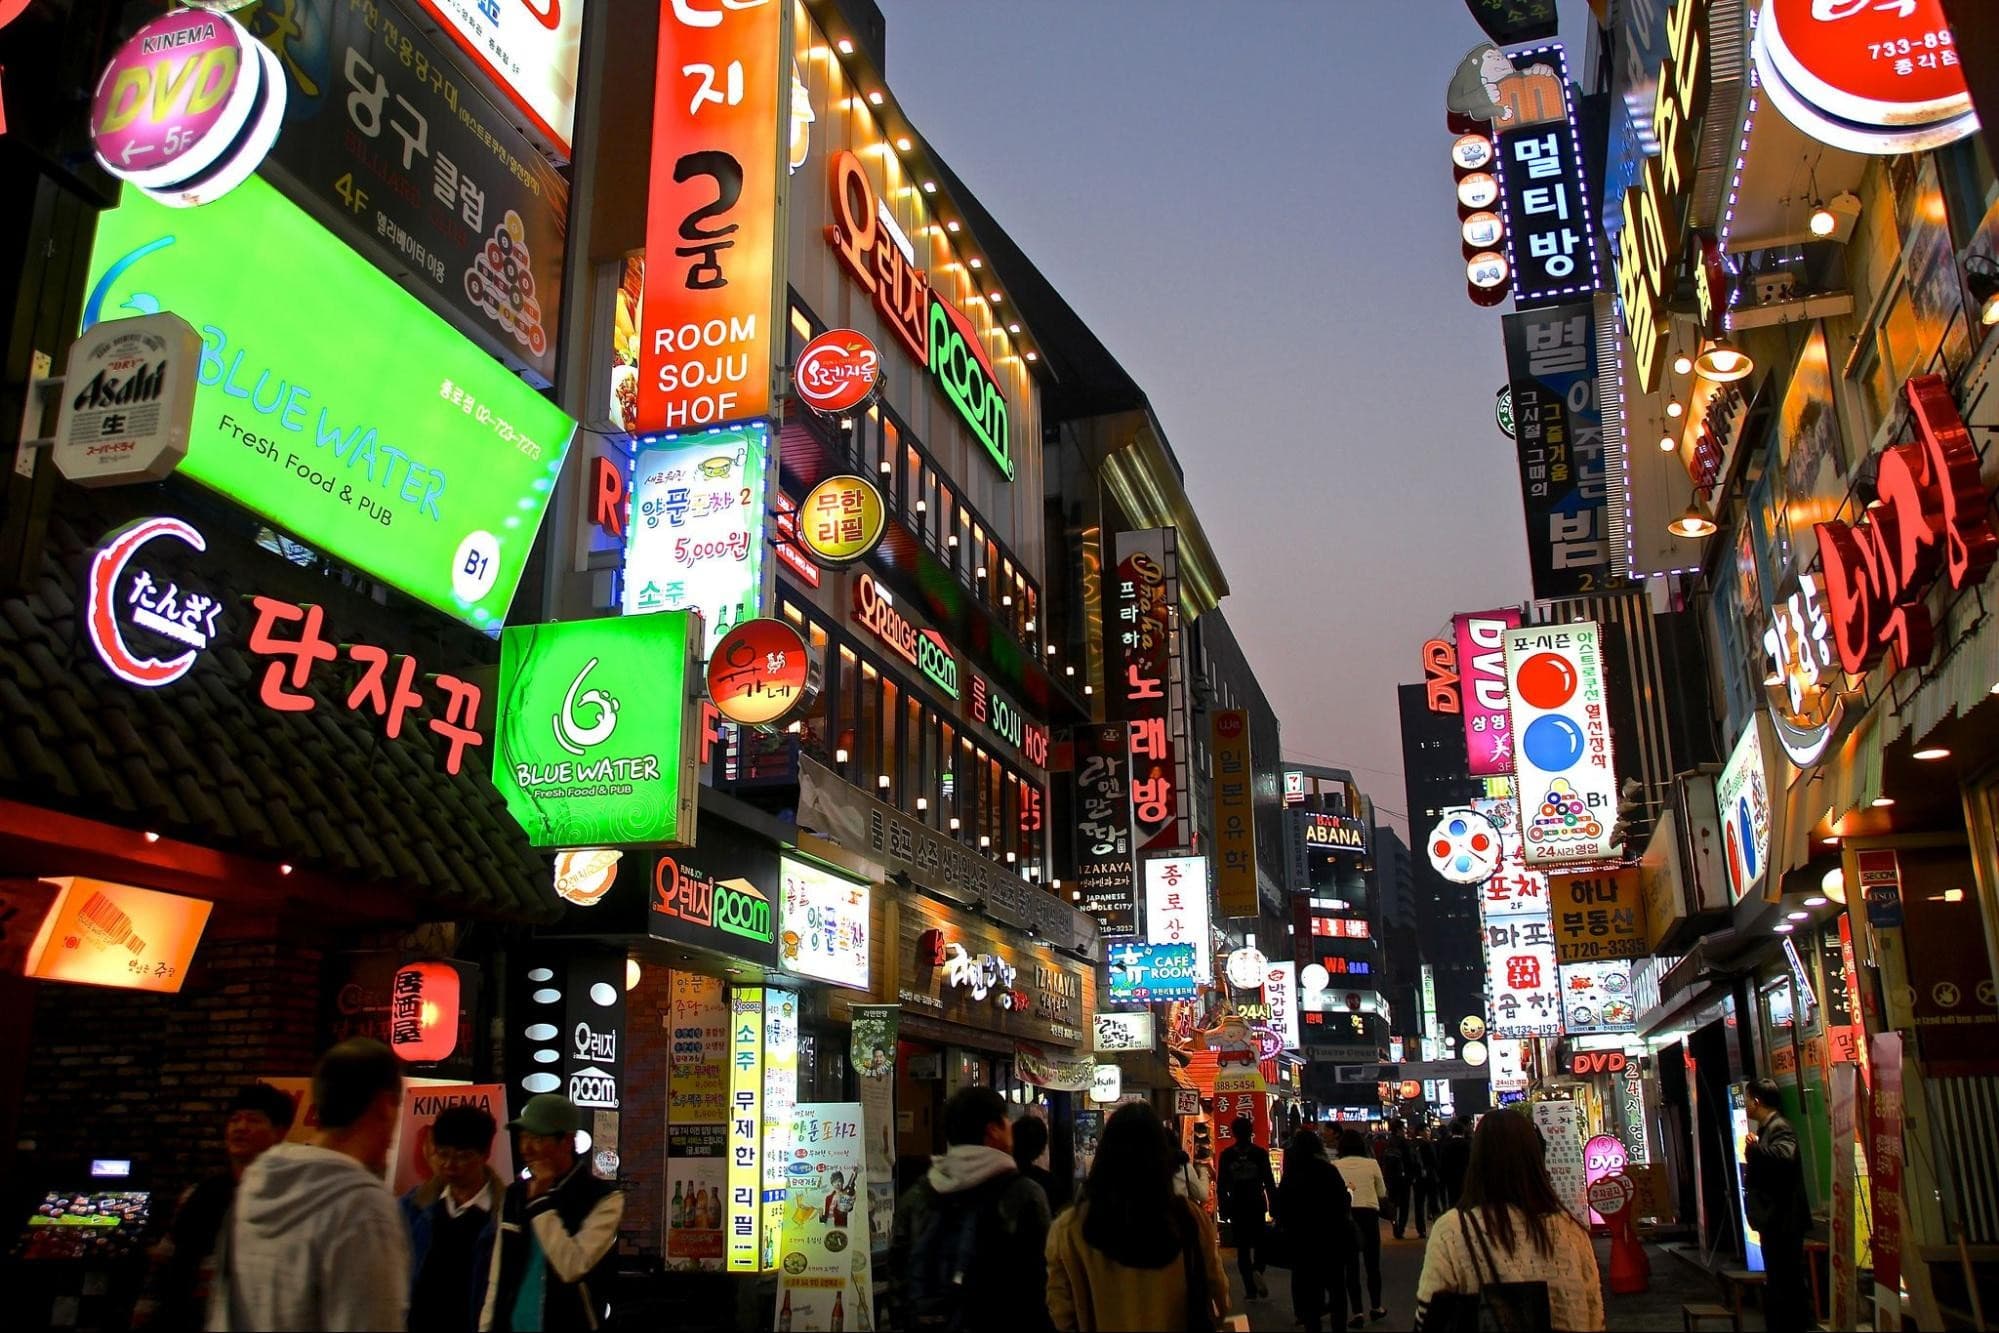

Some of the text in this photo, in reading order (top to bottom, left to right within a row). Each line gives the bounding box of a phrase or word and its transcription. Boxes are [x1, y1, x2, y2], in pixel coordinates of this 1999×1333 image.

[142, 23, 216, 53] KINEMA
[98, 46, 238, 134] DVD
[163, 128, 193, 156] 5F
[344, 46, 429, 170] 당구
[433, 151, 485, 234] 클럽
[335, 173, 369, 214] 4F
[1513, 132, 1581, 278] 멀티방
[376, 211, 446, 284] 엘리베이터 이용
[824, 150, 929, 367] 오렌지
[653, 314, 757, 355] ROOM
[74, 359, 169, 412] Asahi
[657, 353, 749, 392] SOJU
[929, 301, 1015, 483] ROOM
[102, 414, 127, 436] 生
[197, 324, 447, 523] BLUE WATER
[665, 391, 738, 429] HOF
[86, 440, 136, 456] スーパードライ
[285, 454, 336, 494] Food
[339, 485, 354, 504] &
[358, 495, 393, 526] PUB
[816, 489, 865, 517] 무한
[641, 487, 752, 529] 양푼포차 2
[818, 517, 865, 545] 리필
[463, 549, 489, 581] B1
[674, 531, 752, 568] 5,000원
[129, 570, 223, 638] たんざく
[638, 580, 686, 609] 소주
[1119, 580, 1141, 649] 프라하
[858, 573, 961, 701] ORANGE ROOM
[1423, 640, 1461, 714] DVD
[1468, 618, 1510, 711] DVD
[992, 694, 1049, 769] SOJU HOF
[1127, 663, 1171, 823] 노래방
[515, 754, 661, 789] BLUE WATER
[1497, 762, 1512, 772] 3F
[567, 784, 596, 797] Food
[598, 785, 608, 796] &
[610, 784, 633, 795] PUB
[1586, 792, 1609, 808] B1
[1306, 825, 1363, 846] ABANA
[1316, 816, 1341, 828] BAR
[889, 817, 914, 865] 호프
[916, 834, 939, 879] 소주
[1078, 861, 1133, 875] IZAKAYA
[653, 856, 714, 927] 오렌지
[713, 886, 775, 945] ROOM
[1086, 892, 1127, 903] JAPANESE
[1486, 874, 1542, 901] 포차
[1570, 876, 1619, 905] 하나
[1079, 902, 1133, 912] NODLE CITY
[1510, 901, 1524, 910] 2F
[1488, 921, 1554, 948] 마포
[1563, 907, 1635, 938] 부동산
[1034, 964, 1077, 998] IZAKAYA
[1151, 967, 1195, 979] ROOM
[1323, 956, 1370, 974] WA BAR
[1511, 974, 1537, 988] 구이
[1135, 989, 1148, 998] 2F
[1268, 983, 1288, 1035] 박가부대
[1498, 992, 1555, 1019] 곱창
[1237, 1003, 1272, 1020] 24시
[573, 1021, 617, 1064] 오렌지
[1514, 1024, 1558, 1035] 732-1197
[736, 1024, 756, 1072] 소주
[1574, 1053, 1626, 1075] DVD
[413, 1094, 492, 1116] KINEMA
[568, 1075, 620, 1110] ROOM
[735, 1091, 756, 1167] 무제한
[1588, 1154, 1625, 1171] DVD
